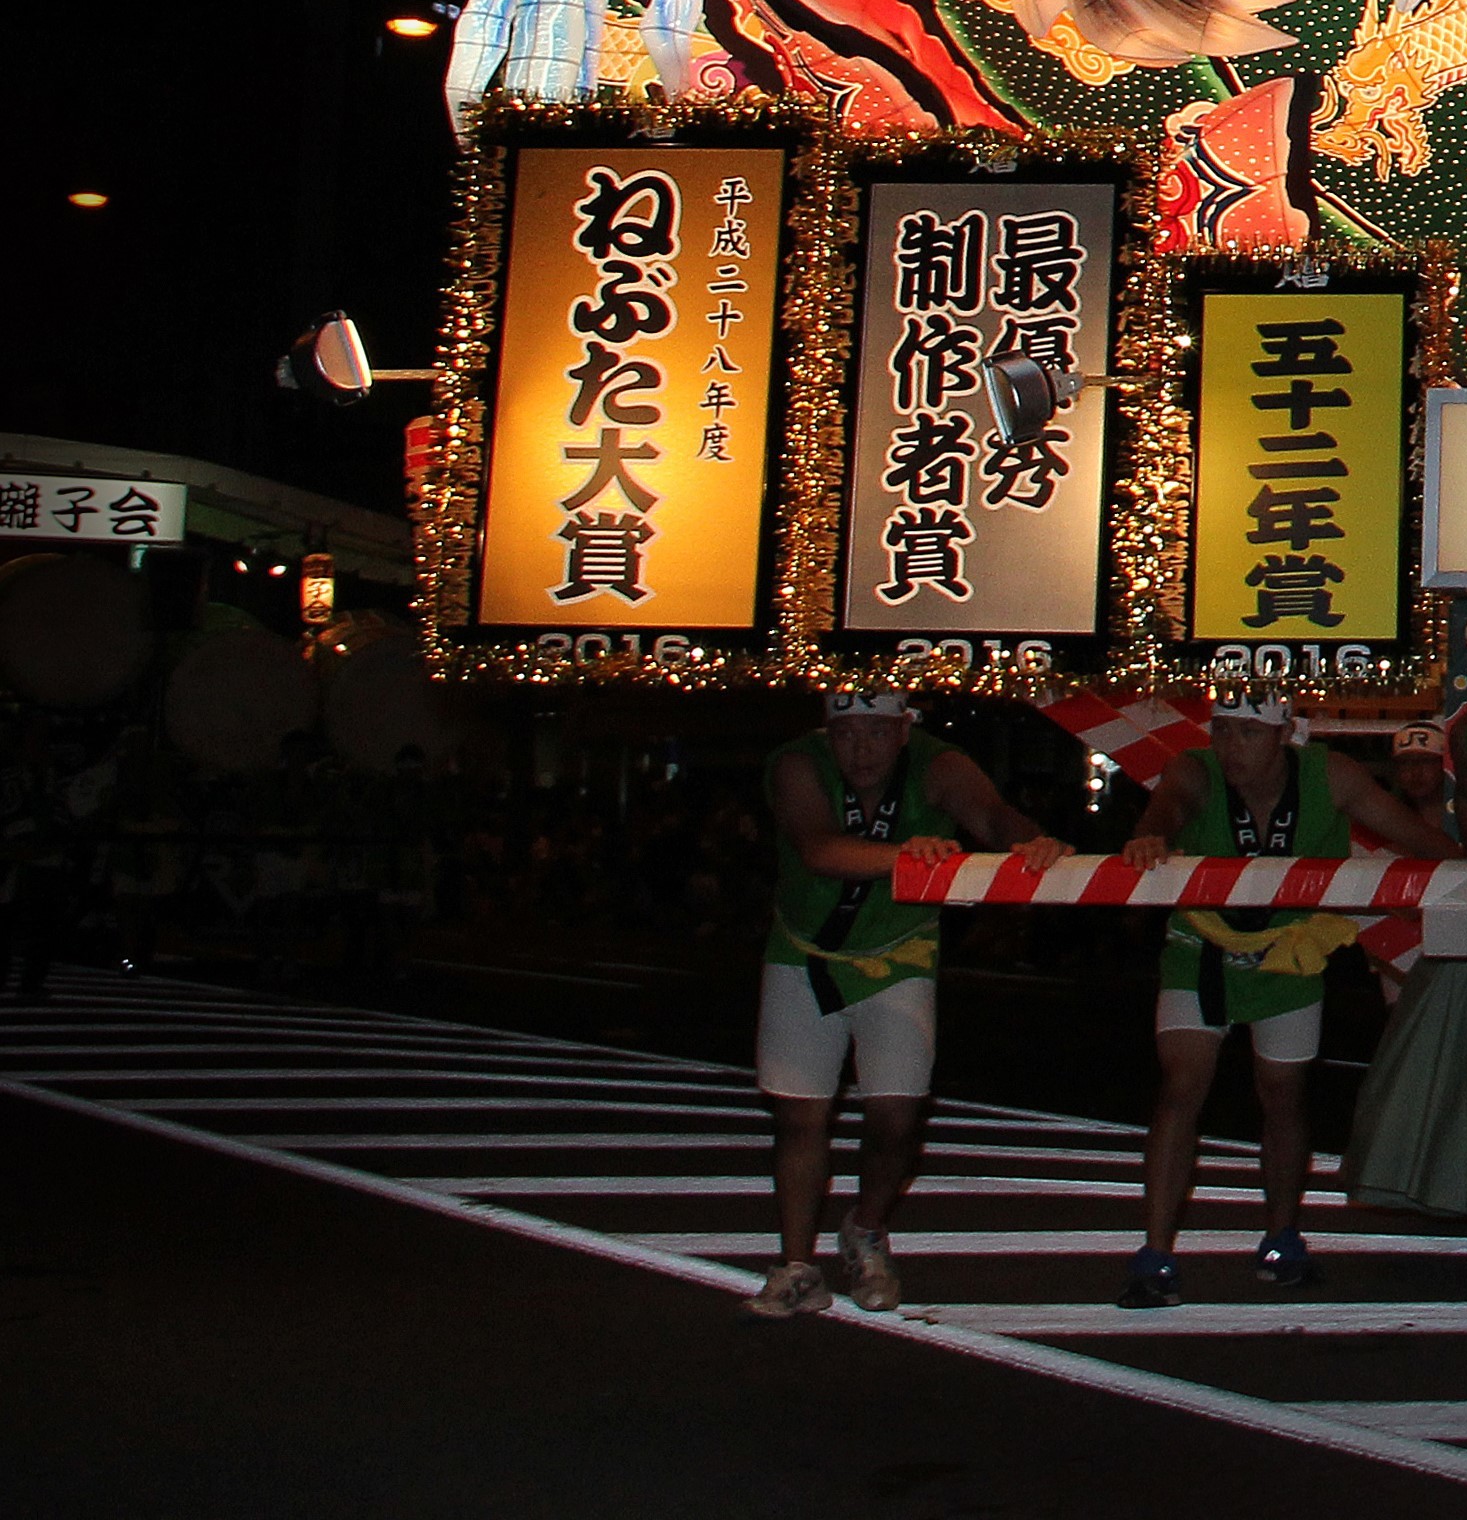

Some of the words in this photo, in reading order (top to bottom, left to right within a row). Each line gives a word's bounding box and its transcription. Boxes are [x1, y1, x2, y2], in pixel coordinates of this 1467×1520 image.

[552, 168, 679, 604] ねぶた大賞
[699, 177, 752, 462] 平成二十八年度
[876, 211, 984, 601] 制作者賞
[1241, 318, 1353, 628] 五十二年賞
[537, 633, 690, 670] 2016
[897, 639, 1052, 674] 2016
[1215, 644, 1371, 680] 2016
[1400, 731, 1429, 747] JR
